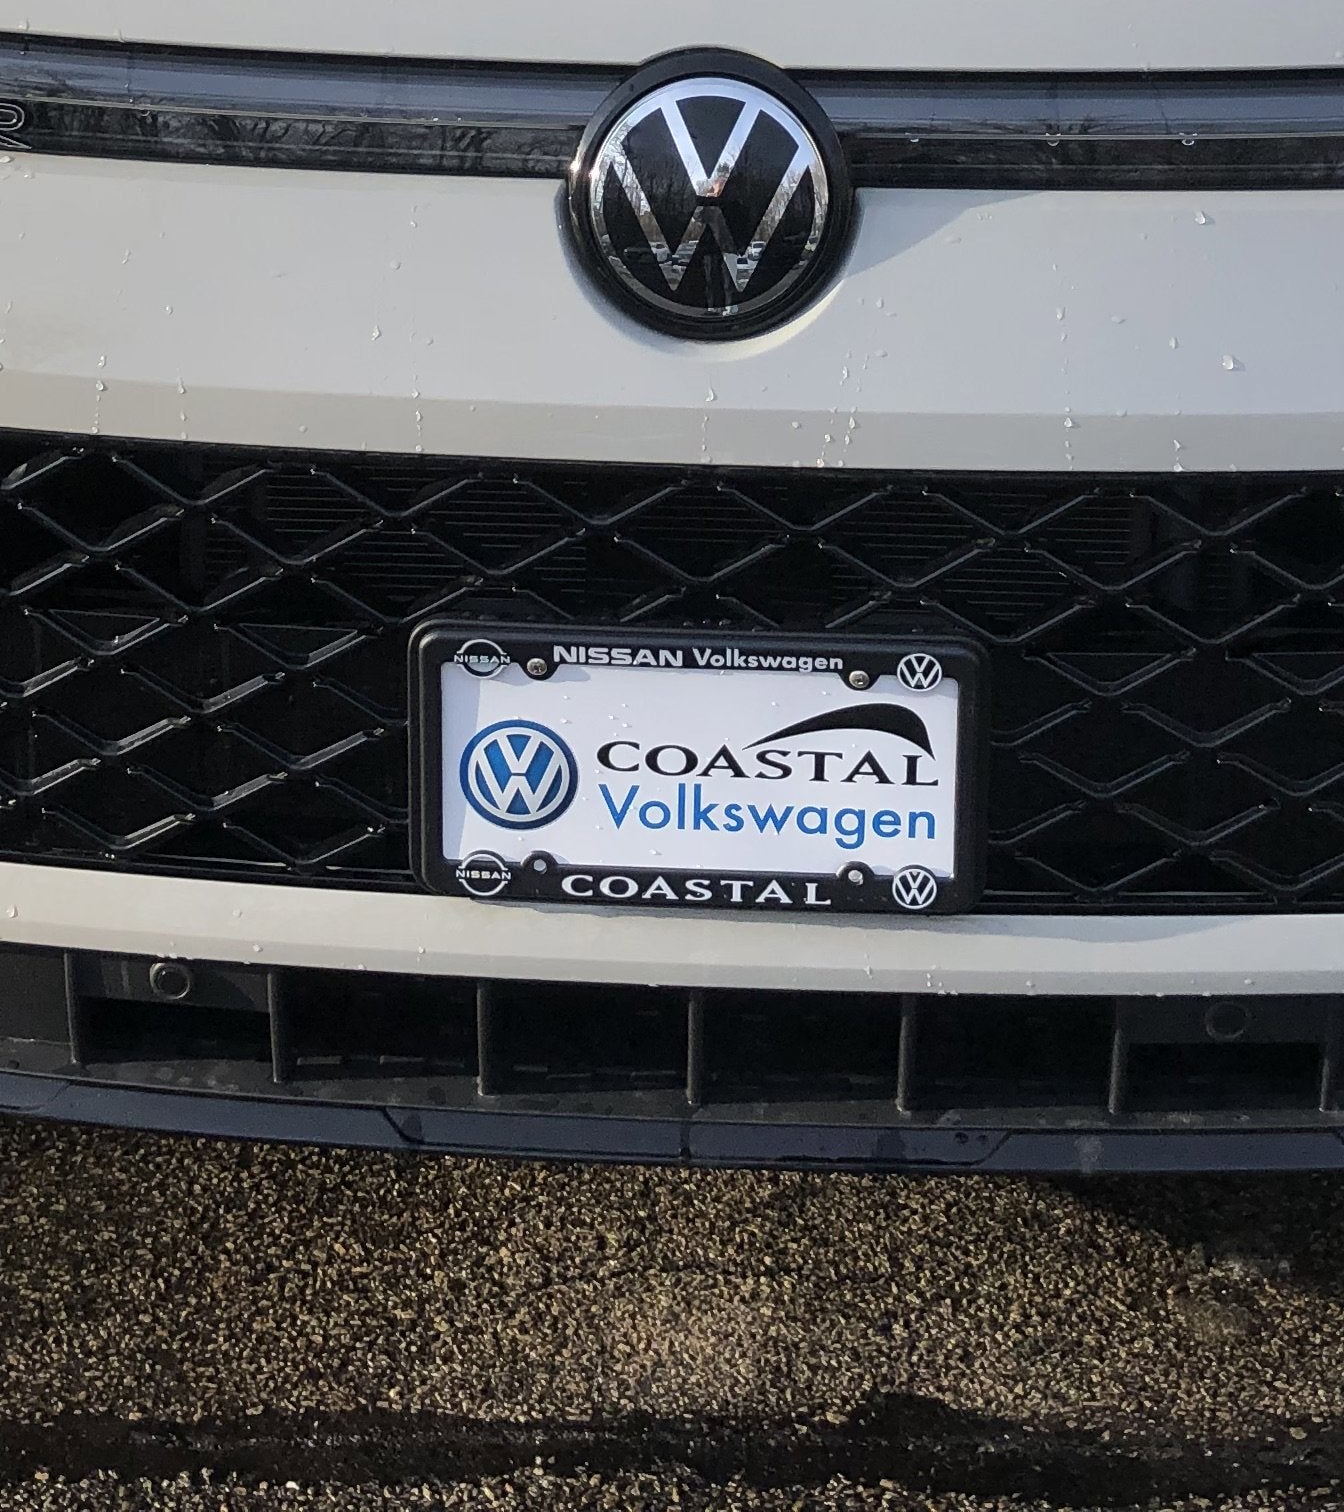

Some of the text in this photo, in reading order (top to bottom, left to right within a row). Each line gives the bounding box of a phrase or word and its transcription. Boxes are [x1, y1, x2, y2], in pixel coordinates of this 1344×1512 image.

[453, 653, 512, 665] NISSAN
[553, 645, 844, 673] NISSAN Volkswagen
[596, 740, 940, 787] COASTAL
[598, 782, 937, 850] Volkswagen
[455, 868, 512, 880] NISSAN
[561, 874, 832, 906] COASTAL
